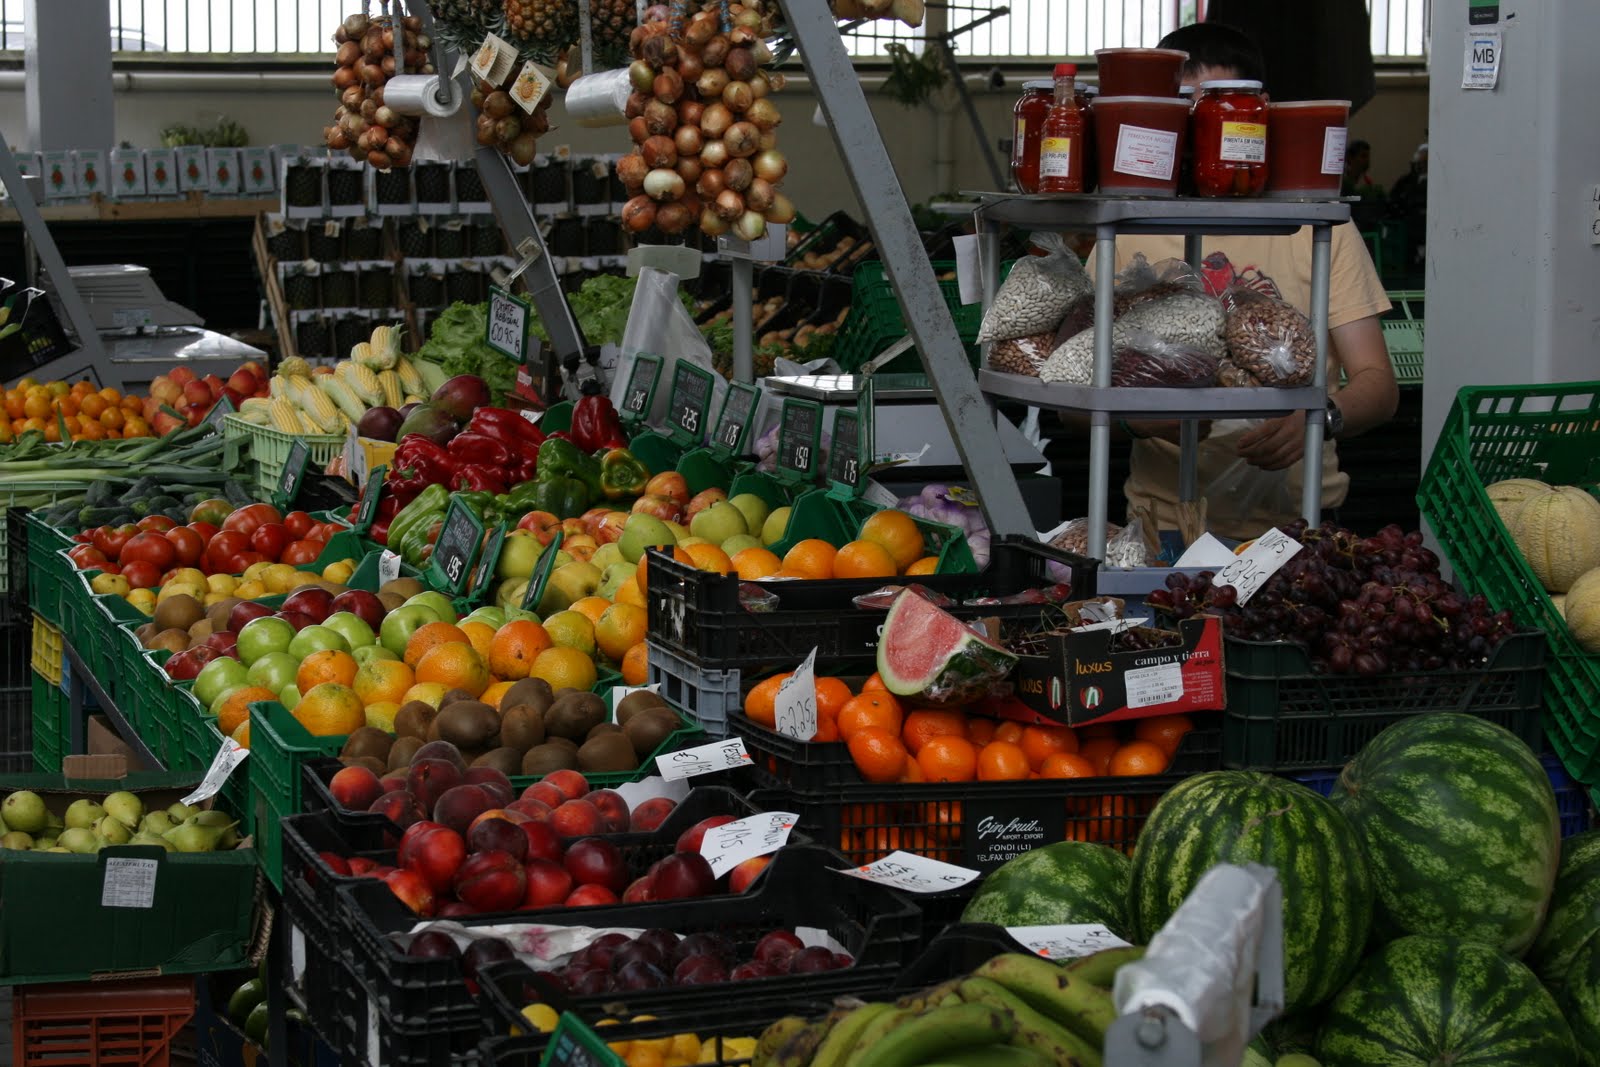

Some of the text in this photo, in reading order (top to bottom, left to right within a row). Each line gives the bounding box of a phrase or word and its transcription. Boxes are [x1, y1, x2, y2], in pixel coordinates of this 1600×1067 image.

[1473, 48, 1495, 64] MB
[1258, 532, 1290, 554] UVAS
[1134, 655, 1171, 667] campo
[1182, 649, 1210, 661] tierra
[1075, 658, 1113, 677] luxus
[989, 844, 1015, 852] FONDI
